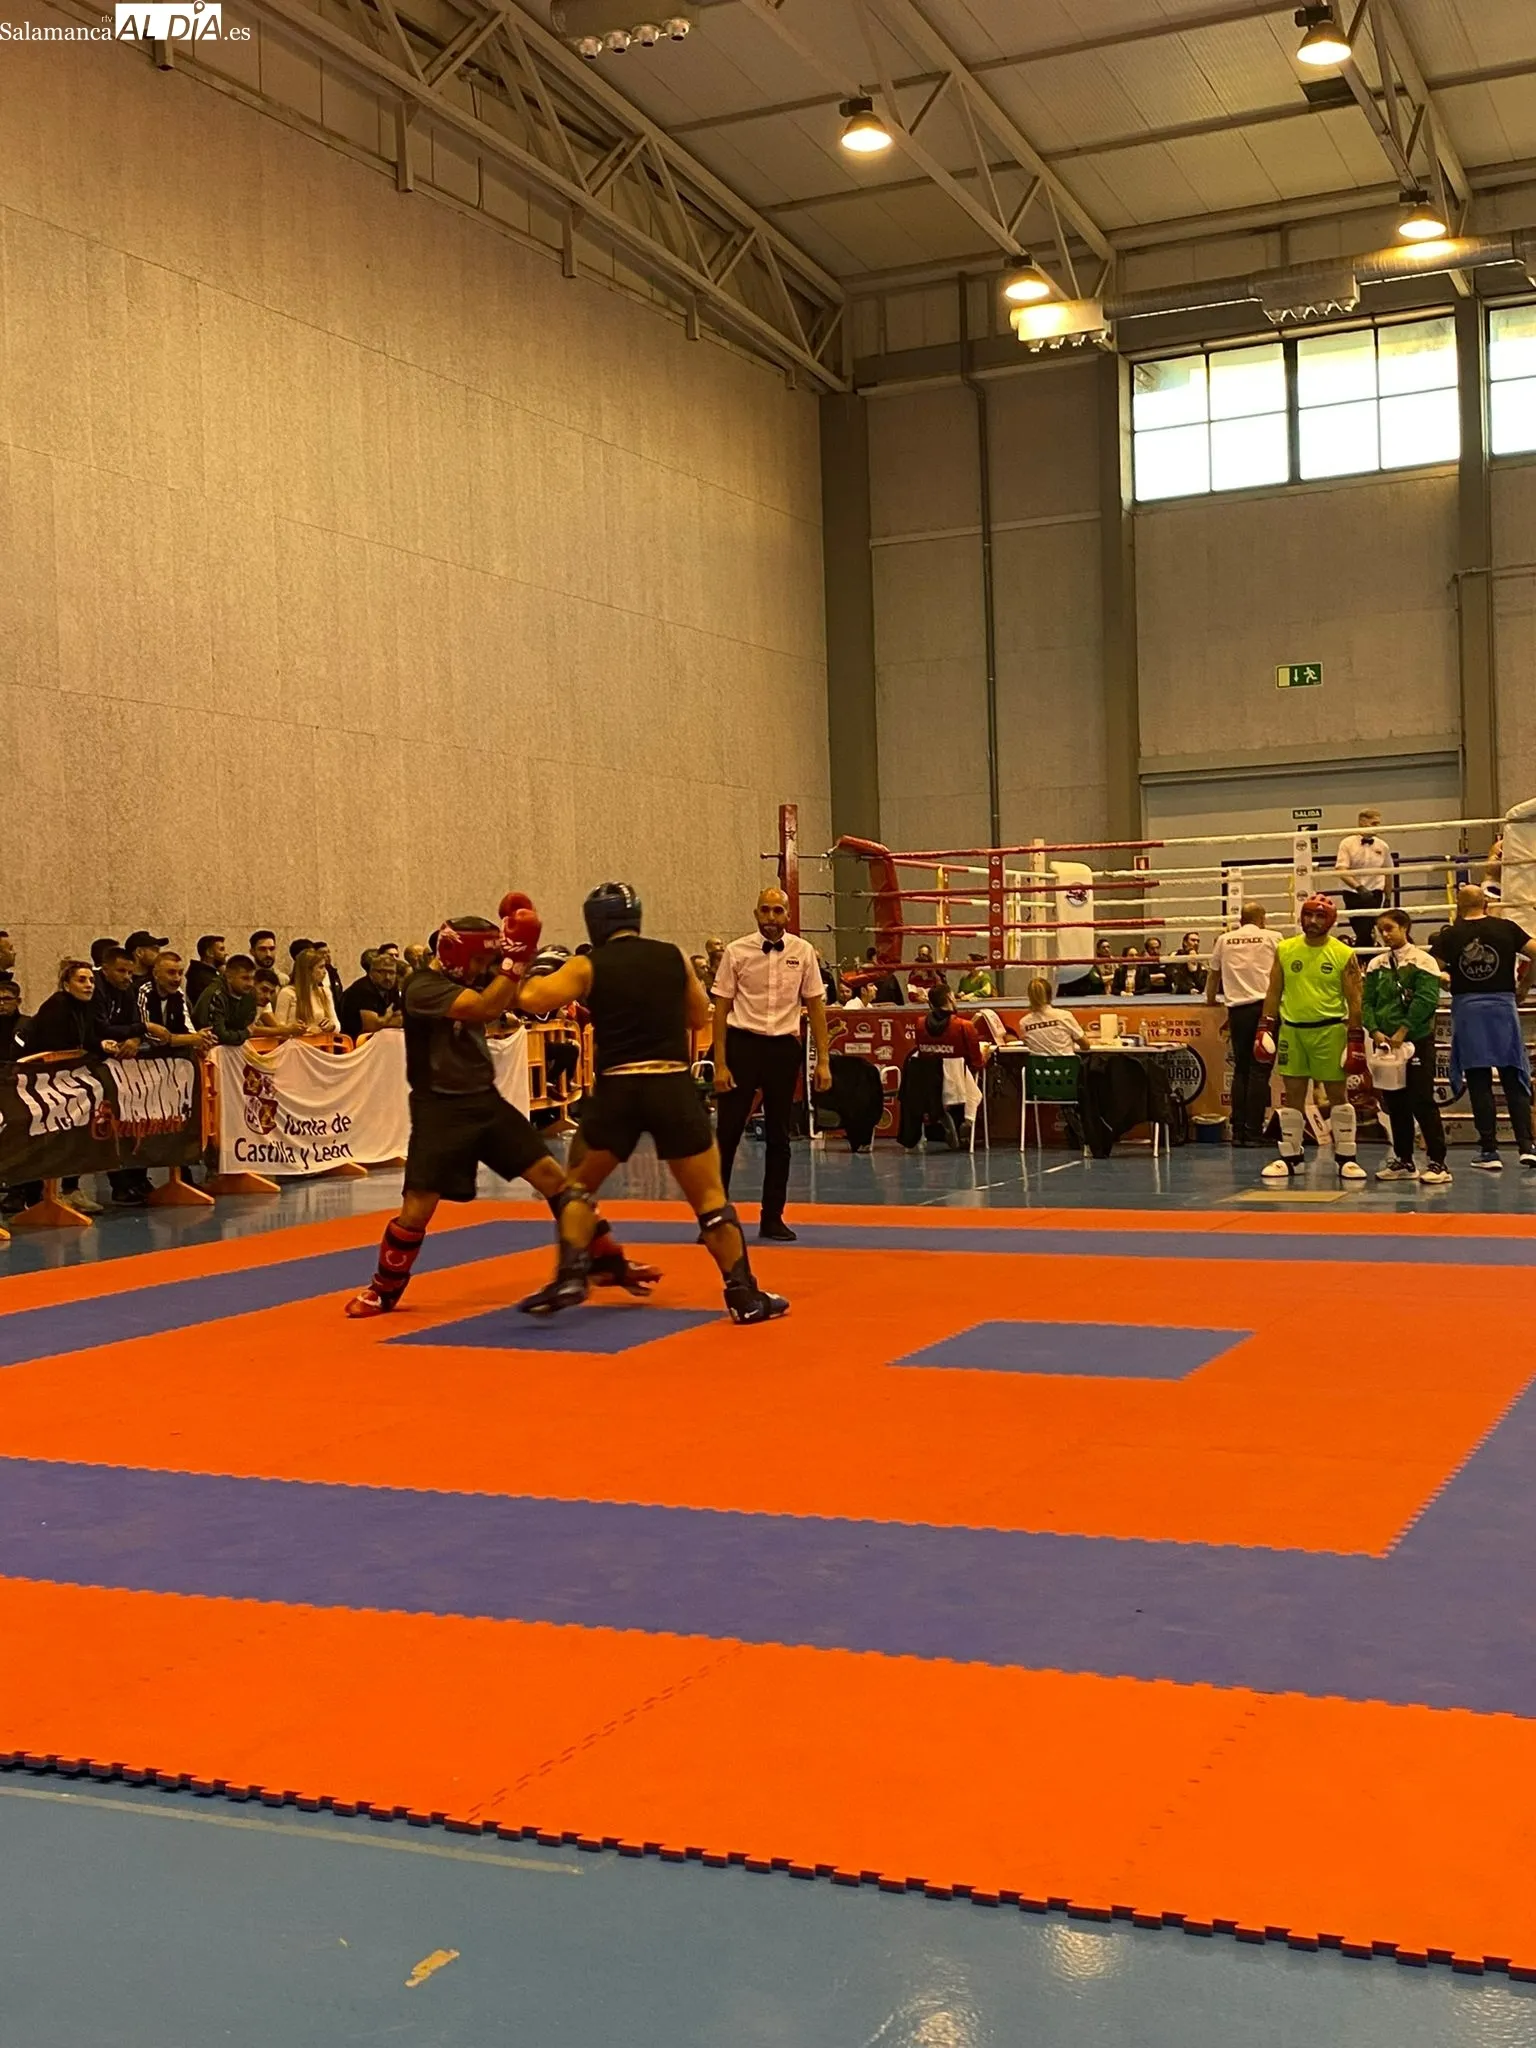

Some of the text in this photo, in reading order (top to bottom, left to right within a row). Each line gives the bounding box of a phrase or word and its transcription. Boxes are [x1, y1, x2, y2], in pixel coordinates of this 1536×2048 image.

[331, 1113, 352, 1134] de
[234, 1137, 353, 1170] Castilla y León
